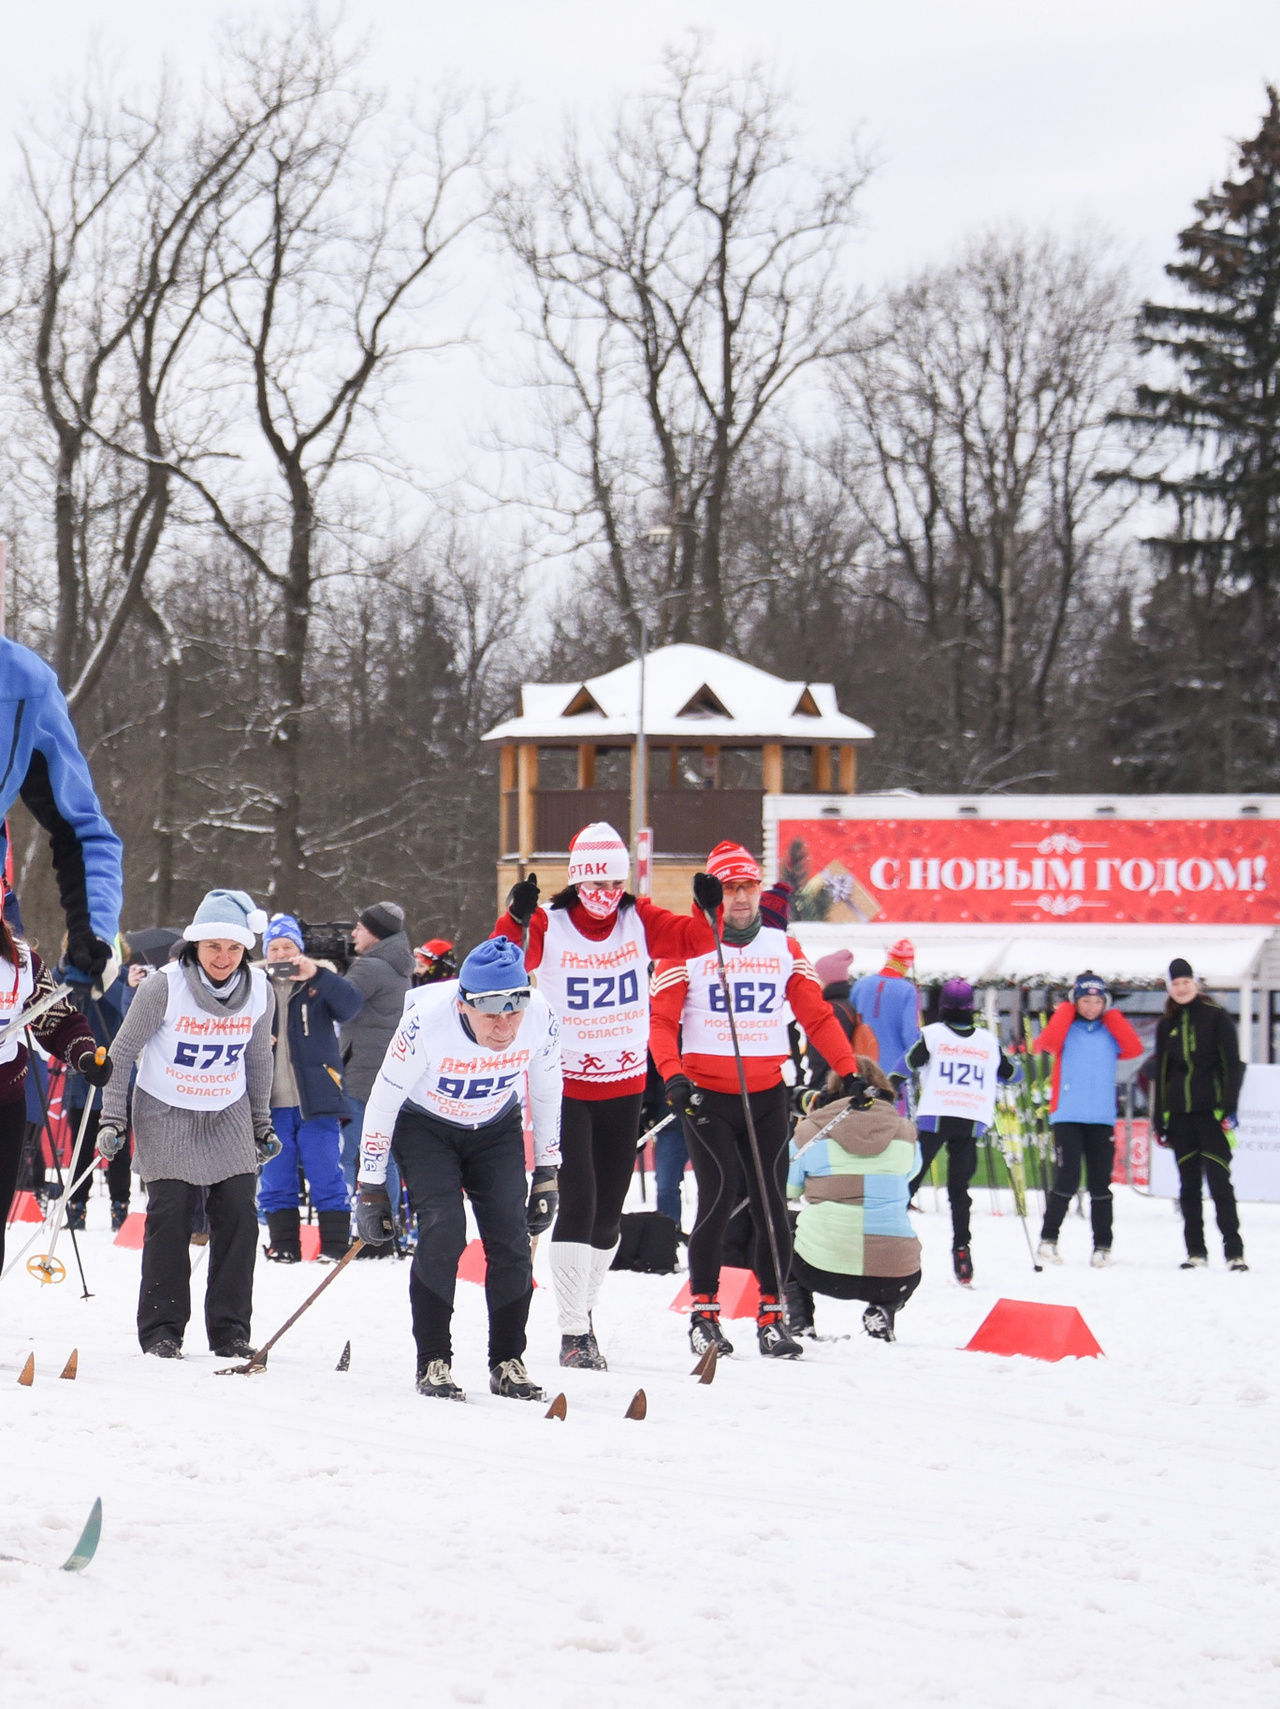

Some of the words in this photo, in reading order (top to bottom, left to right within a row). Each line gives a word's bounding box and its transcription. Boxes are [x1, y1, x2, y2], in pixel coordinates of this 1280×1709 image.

[869, 857, 902, 891] С
[907, 857, 1087, 891] НОВЫМ
[1094, 855, 1268, 897] ГОДОМ!
[560, 940, 639, 970] ЛЫЖНЯ
[566, 968, 639, 1010] 520
[174, 1016, 252, 1036] ЛЫЖНЯ
[562, 1008, 645, 1026] МОСКОВСКАЯ
[577, 1026, 633, 1040] ОБЛАСТЬ
[940, 1061, 984, 1089] 424
[176, 1084, 232, 1097] ОБЛАСТЬ
